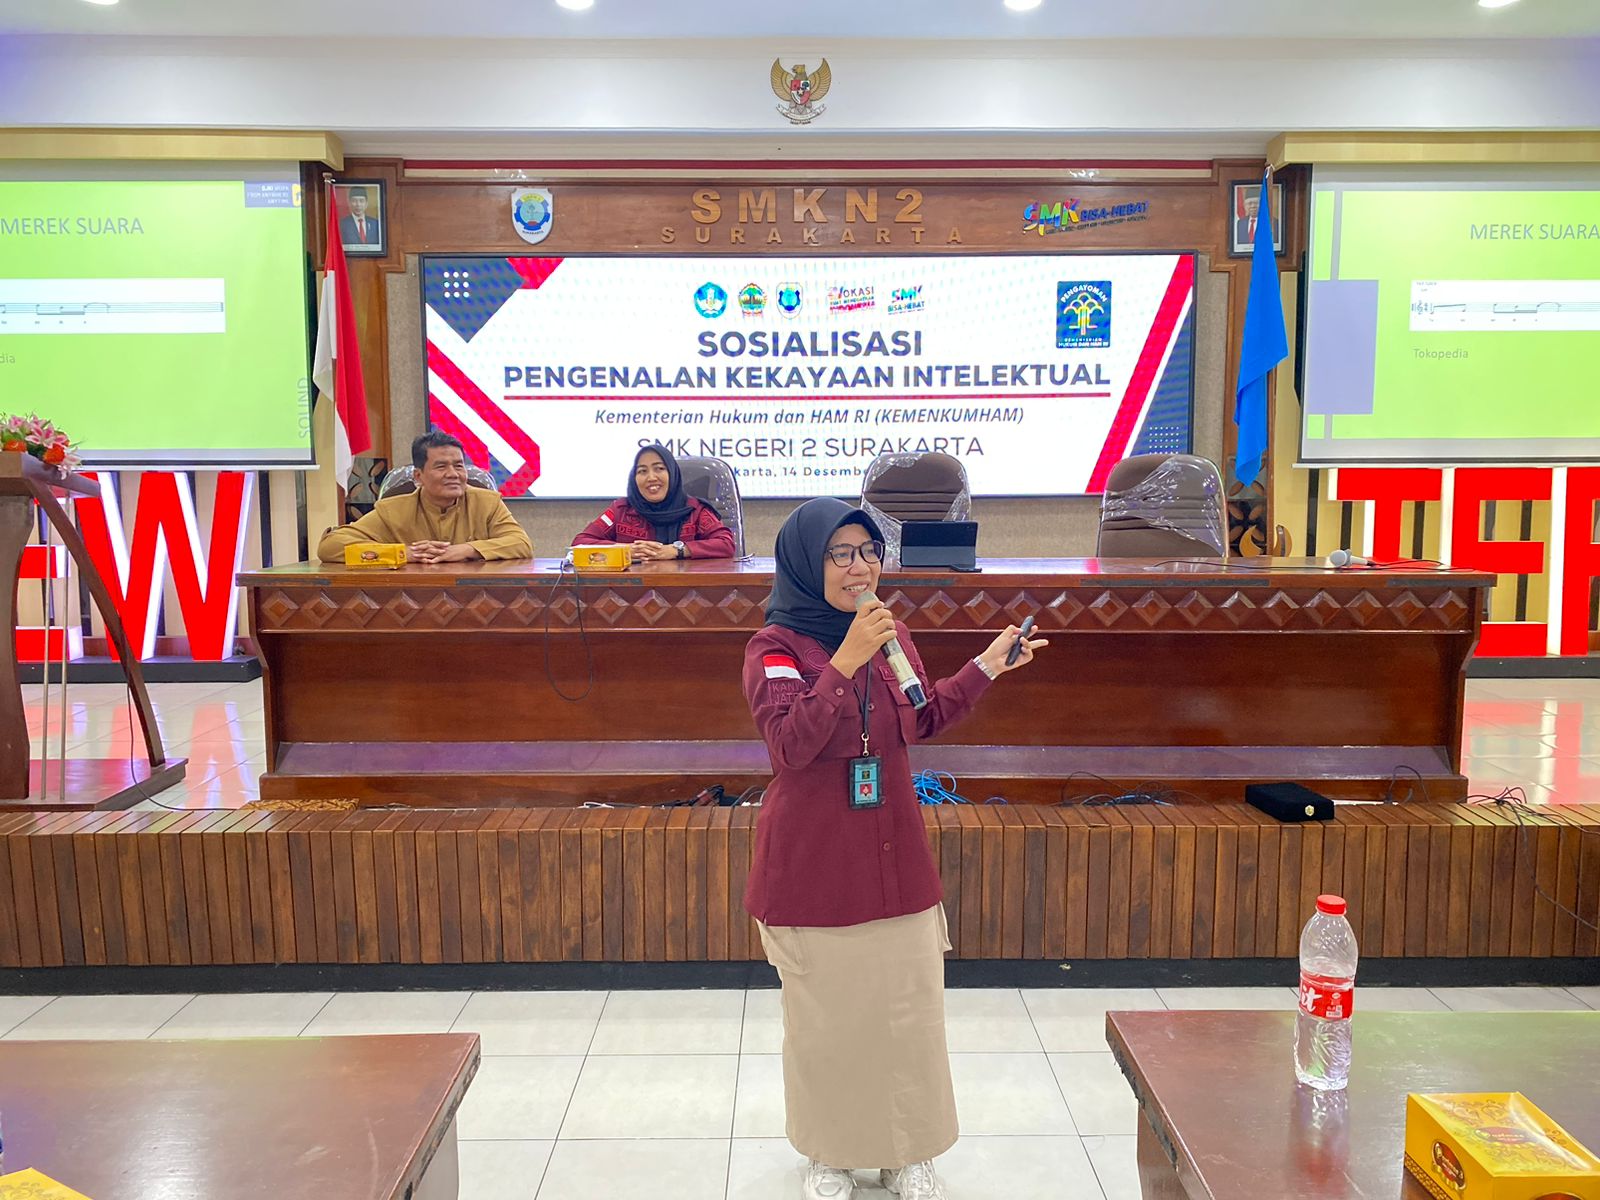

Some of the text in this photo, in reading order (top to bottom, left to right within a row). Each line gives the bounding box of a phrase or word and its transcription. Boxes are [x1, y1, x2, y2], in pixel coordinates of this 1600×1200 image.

[1, 217, 144, 235] MEREK SUARA
[1022, 198, 1081, 236] SMK
[1080, 199, 1150, 222] BISA-HEBAT
[660, 226, 964, 244] SURAKARTA
[1470, 223, 1600, 240] MEREK SUARA
[1060, 284, 1108, 303] PENGAYOMAN
[697, 330, 922, 357] SOSIALISASI
[1413, 348, 1469, 361] Tokopedia
[503, 363, 1111, 388] PENGENALAN KEKAYAAN INTELEKTUAL
[594, 407, 1025, 425] Kementerian Hukum dan HAM RI (KEMENKUMHAM)
[700, 438, 793, 457] NEGERI
[802, 438, 817, 457] 2
[825, 437, 985, 457] SURAKARTA
[733, 466, 868, 478] karta, 14 Desemb
